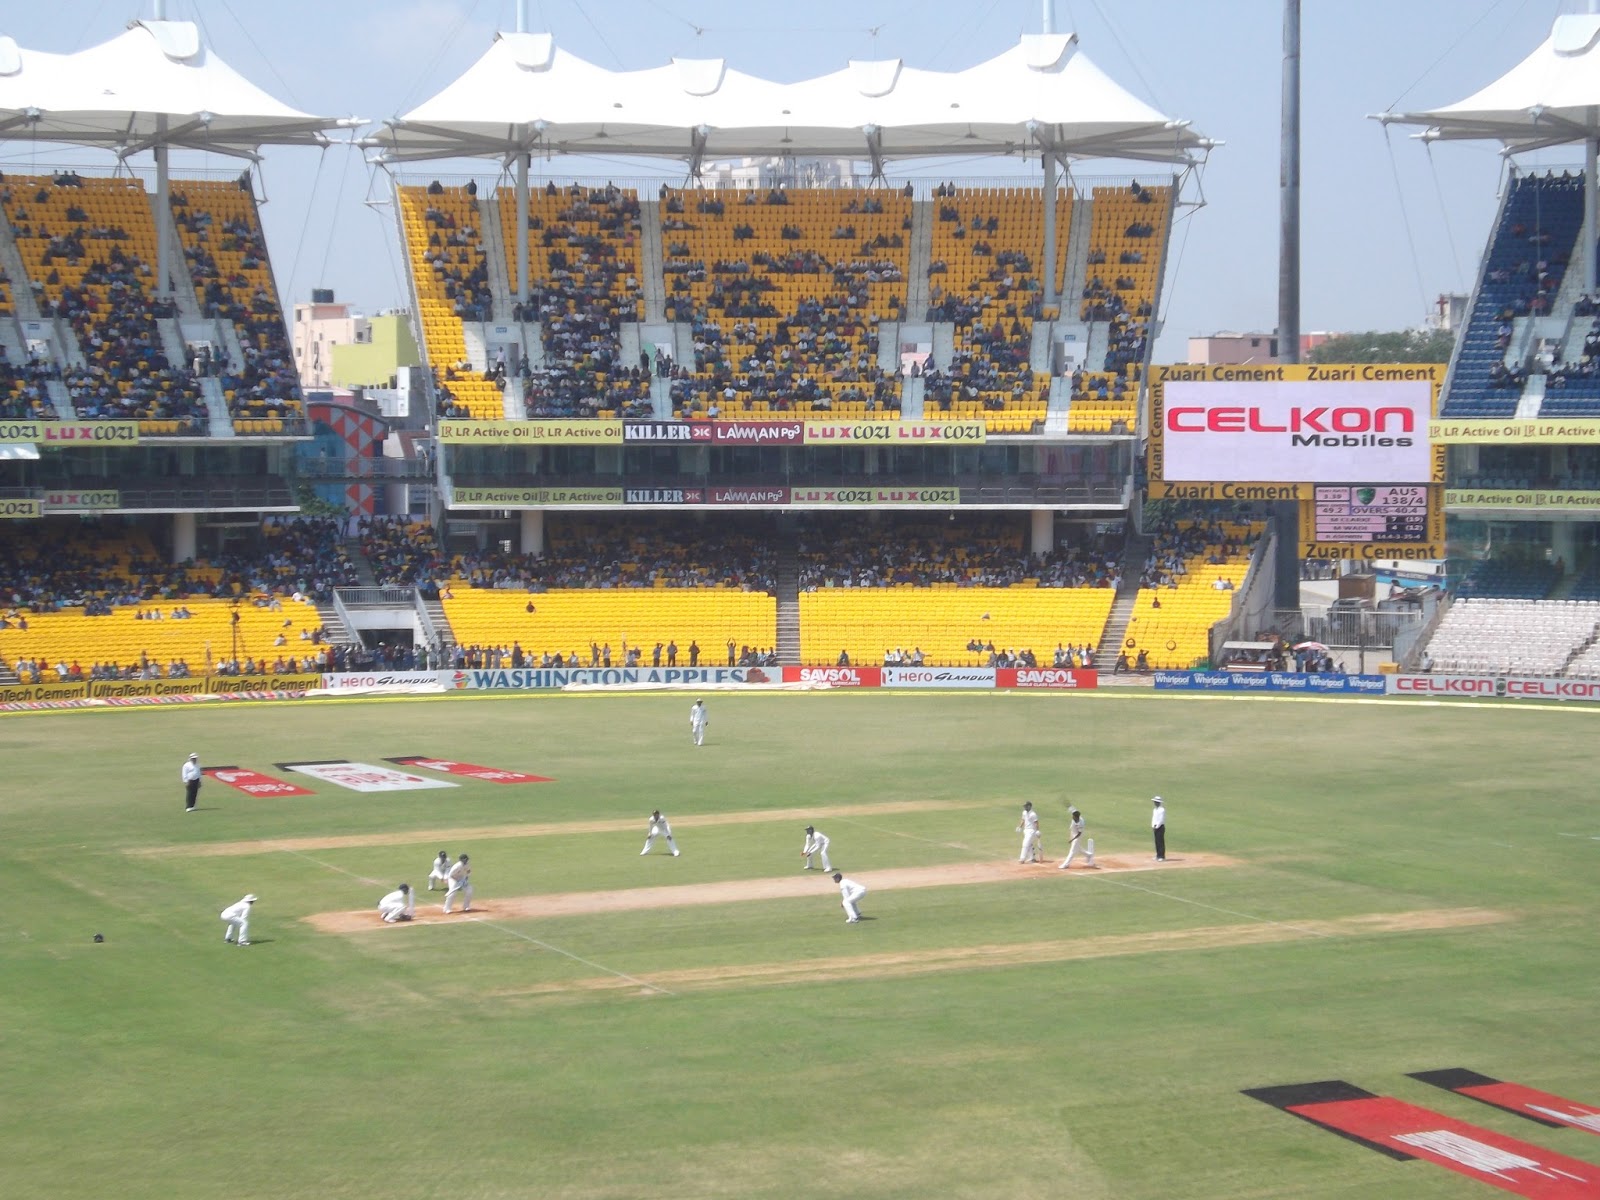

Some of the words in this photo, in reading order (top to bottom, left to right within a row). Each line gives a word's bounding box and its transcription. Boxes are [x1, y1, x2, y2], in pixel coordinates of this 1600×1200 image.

[1159, 366, 1206, 381] Zuari
[1212, 366, 1284, 381] Cement
[1308, 365, 1355, 380] Zuari
[1362, 366, 1436, 380] Cement
[1151, 383, 1163, 438] Cement
[1167, 406, 1415, 433] CELKON
[45, 427, 93, 440] LUX
[455, 427, 470, 437] LR
[473, 426, 510, 437] Active
[512, 427, 529, 437] Oil
[547, 427, 562, 437] LR
[564, 426, 601, 437] Active
[604, 427, 621, 437] Oil
[624, 424, 692, 440] KILLER
[717, 423, 779, 442] LAWMAN
[808, 426, 852, 439] LUX
[898, 426, 942, 438] LUX
[1444, 427, 1459, 437] LR
[1462, 426, 1500, 437] Active
[1503, 427, 1521, 437] Oil
[1539, 426, 1554, 436] LR
[1557, 426, 1595, 436] Active
[1291, 434, 1414, 448] Mobiles
[1151, 443, 1162, 480] Zuari
[469, 492, 482, 501] LR
[485, 492, 521, 501] Active
[522, 492, 538, 501] Oil
[552, 492, 566, 501] LR
[569, 492, 604, 501] Active
[605, 492, 621, 501] Oil
[626, 490, 684, 502] KILLER
[716, 489, 766, 503] LAWMAN
[1163, 482, 1215, 499] Zuari
[1222, 483, 1300, 499] Cement
[1389, 488, 1418, 496] AUS
[1382, 496, 1424, 506] 138/4
[1460, 494, 1474, 504] LR
[1477, 494, 1512, 504] Active
[1515, 494, 1532, 504] Oil
[1550, 495, 1563, 504] LR
[1306, 543, 1354, 558] Zuari
[1361, 544, 1437, 559] Cement
[376, 676, 437, 686] GLAMOUR
[473, 669, 638, 688] WASHINGTON
[800, 668, 861, 682] SAVSOL
[934, 672, 994, 681] GLAMOUR
[1016, 670, 1077, 683] SAVSOL
[1155, 674, 1190, 685] Whirlpool
[1194, 675, 1230, 685] Whirlpool
[1232, 675, 1268, 686] Whirlpool
[211, 679, 268, 693] UltraTech
[270, 677, 318, 690] Cement
[1271, 676, 1307, 687] Whirlpool
[1309, 677, 1344, 688] Whirlpool
[1348, 678, 1384, 689] Whirlpool
[1396, 677, 1494, 693] CELKON
[35, 685, 85, 700] Cement
[93, 683, 151, 698] UltraTech
[154, 681, 203, 695] Cement
